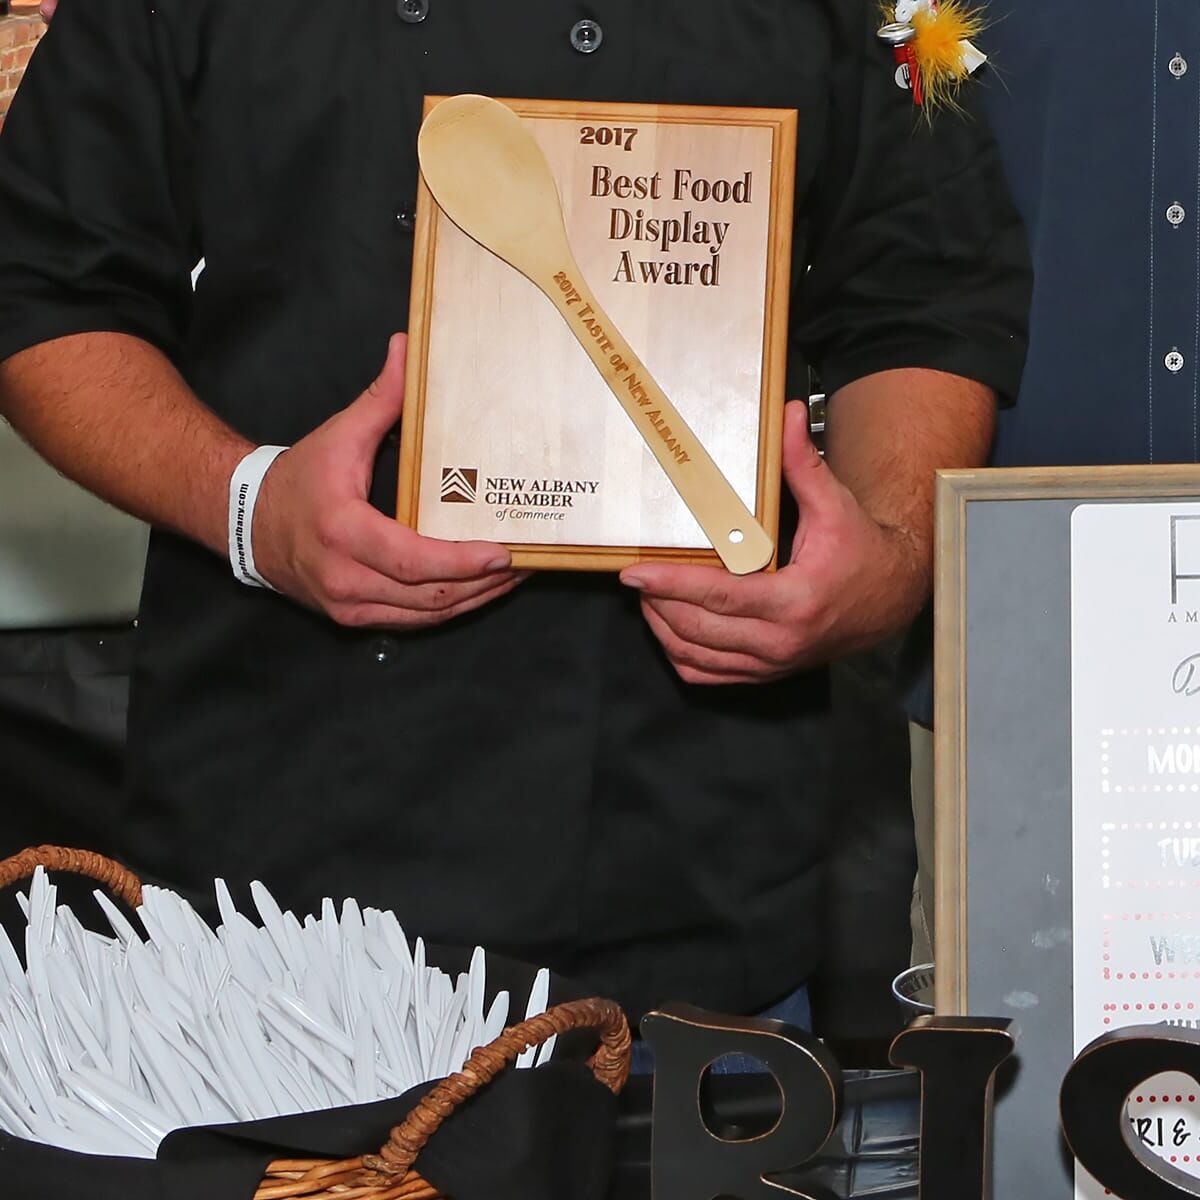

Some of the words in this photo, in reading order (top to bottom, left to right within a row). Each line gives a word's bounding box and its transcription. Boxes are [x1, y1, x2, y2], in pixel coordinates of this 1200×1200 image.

[580, 126, 638, 151] 2017
[591, 165, 662, 200] Best
[672, 169, 752, 203] Food
[608, 208, 730, 253] Display
[612, 250, 720, 286] Award
[553, 271, 582, 305] 2017
[485, 477, 526, 491] NEW
[530, 479, 599, 494] ALBANY
[485, 492, 573, 507] CHAMBER
[496, 508, 507, 521] of
[510, 509, 565, 521] Commerce
[1172, 1118, 1191, 1146] &
